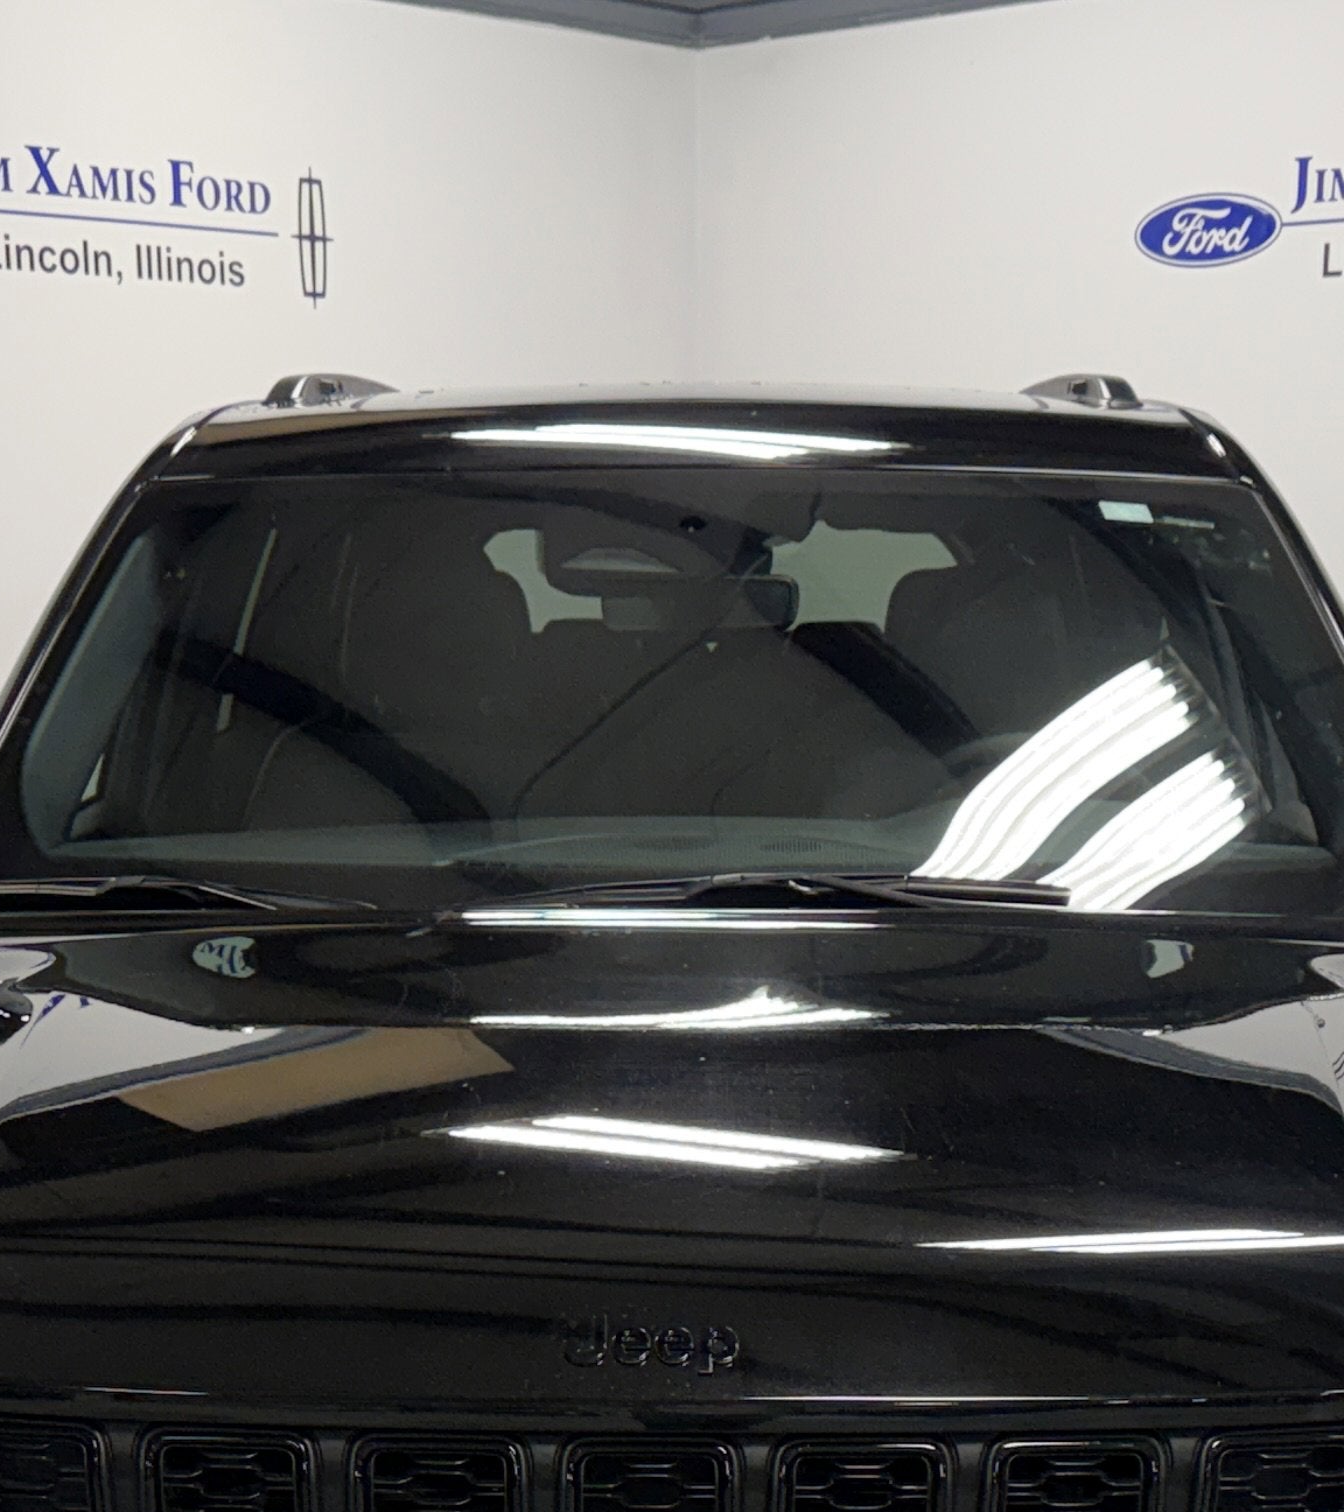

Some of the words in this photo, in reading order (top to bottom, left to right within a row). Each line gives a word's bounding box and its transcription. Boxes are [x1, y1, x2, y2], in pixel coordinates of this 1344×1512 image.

[25, 145, 156, 204] XAMIS
[168, 159, 271, 214] FORD
[1162, 207, 1252, 256] Ford
[135, 244, 246, 287] Illinois
[563, 1314, 739, 1375] Jeep
